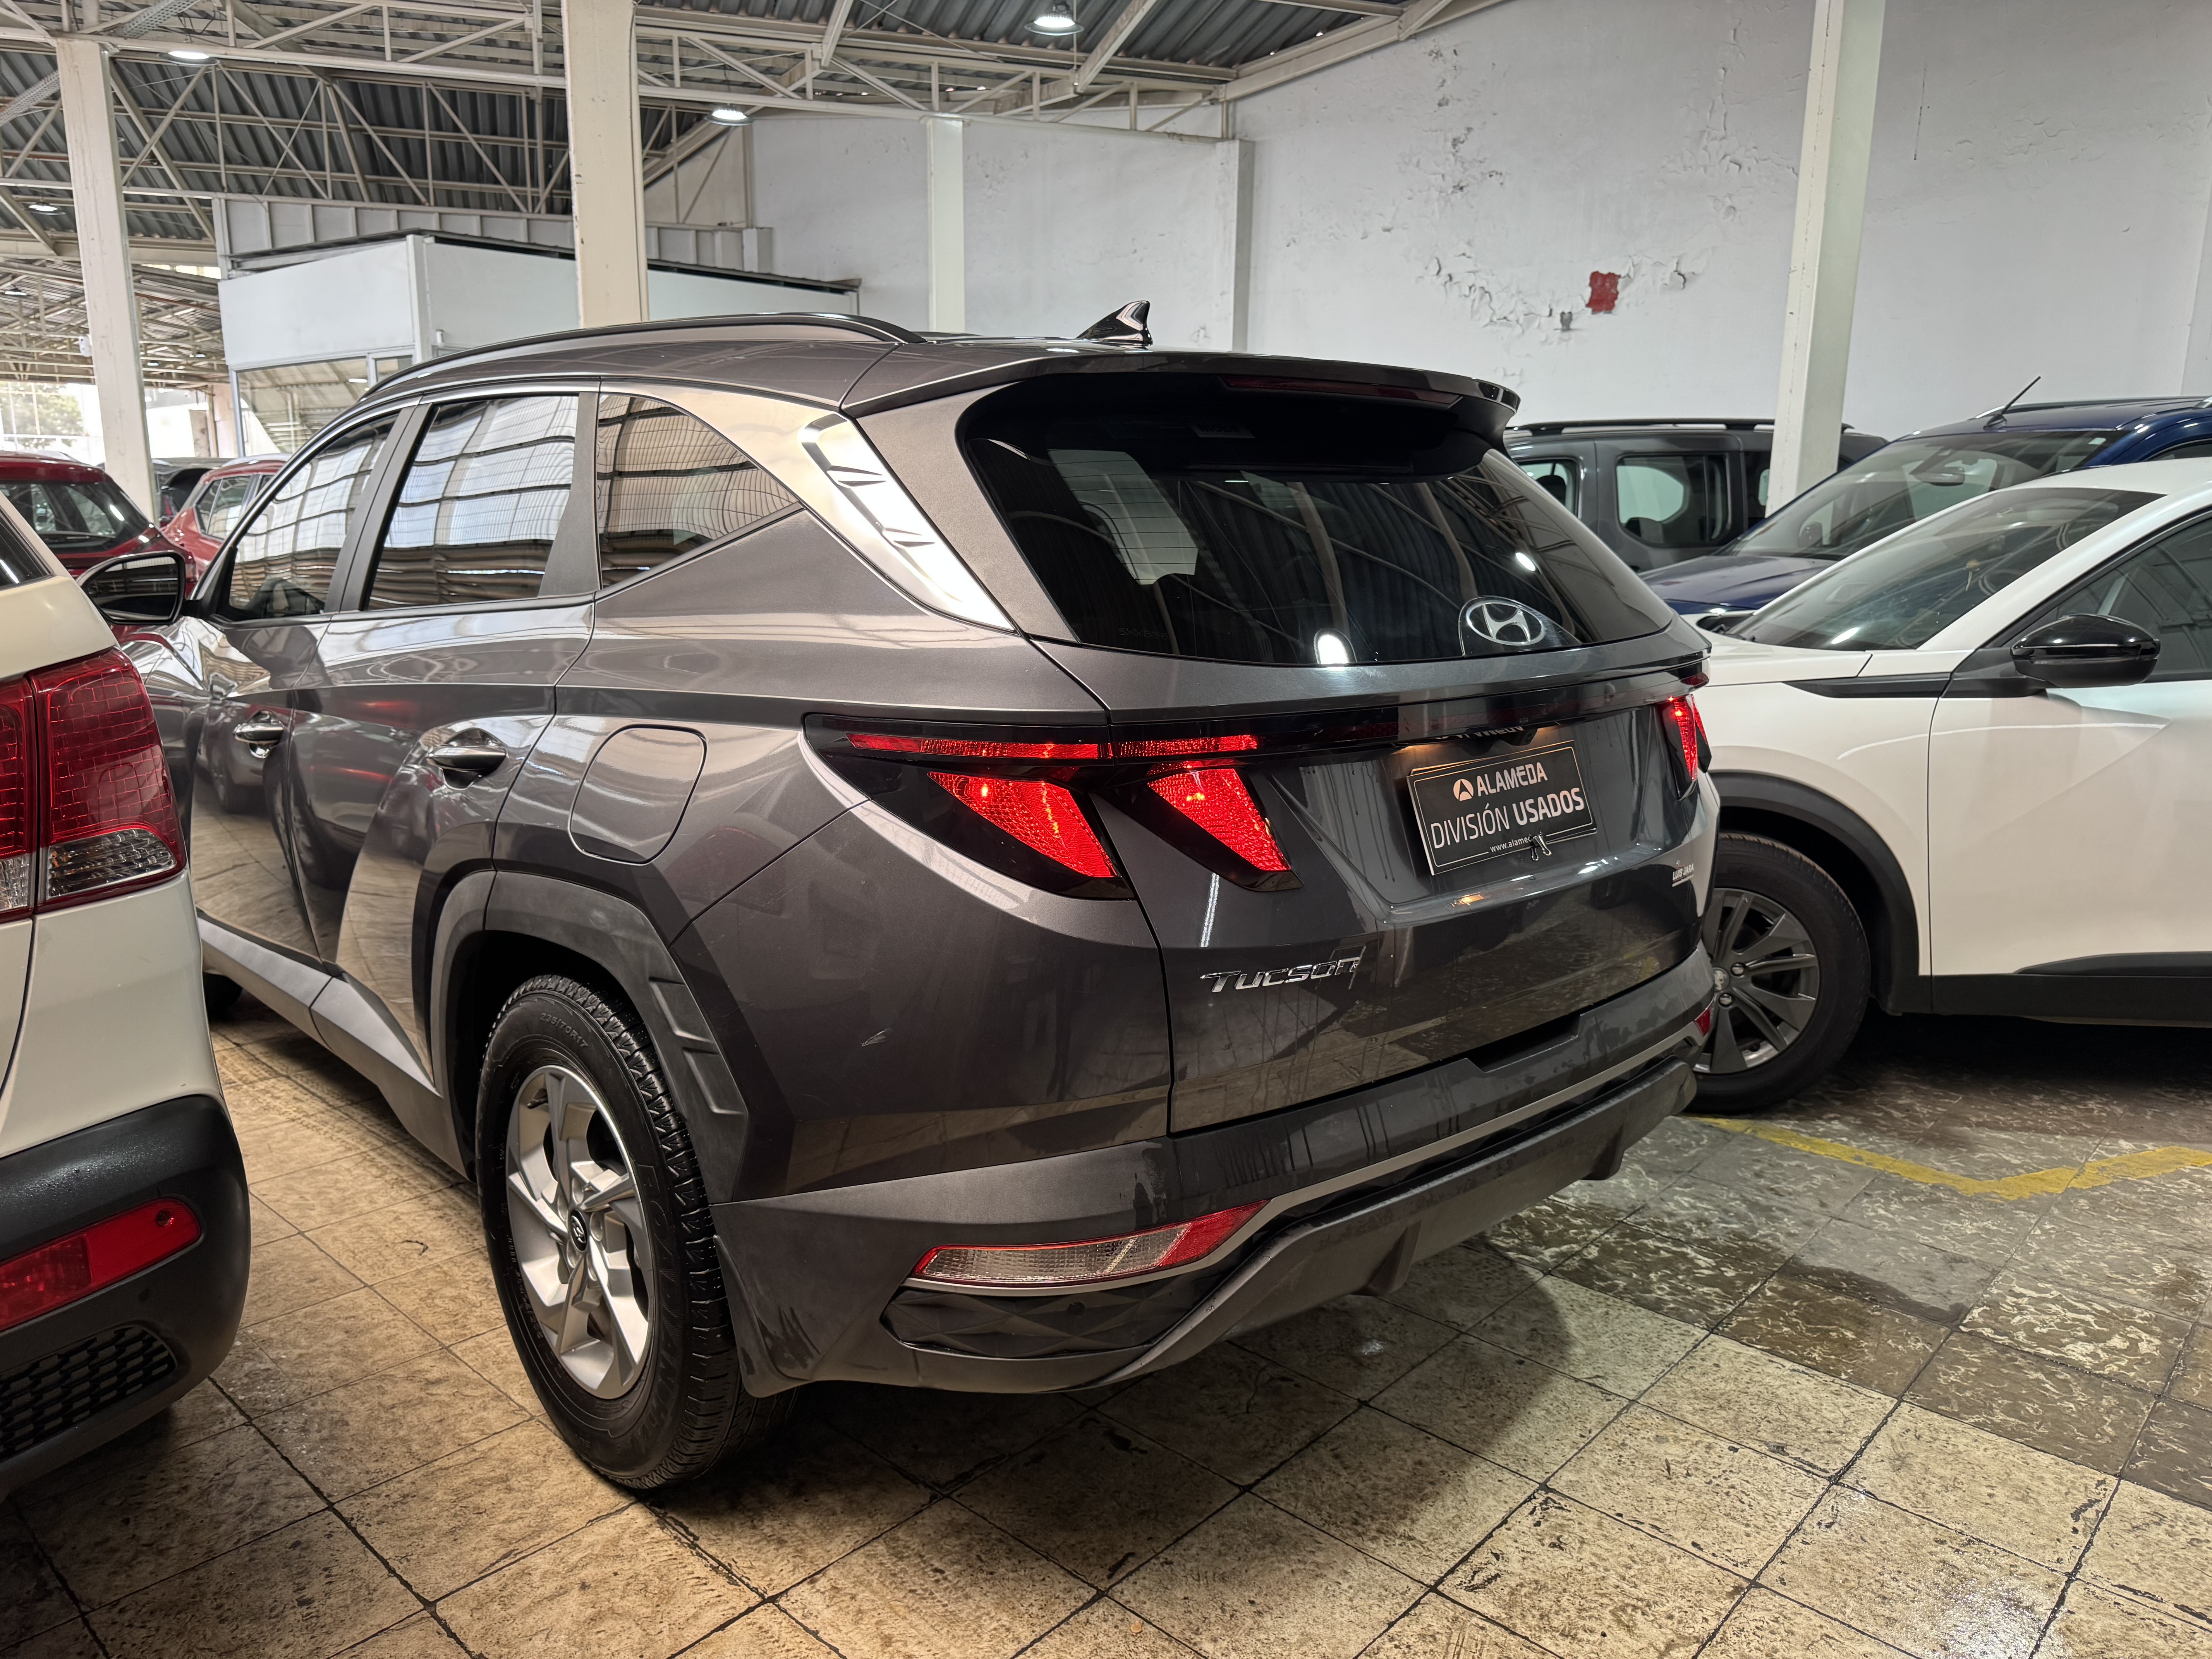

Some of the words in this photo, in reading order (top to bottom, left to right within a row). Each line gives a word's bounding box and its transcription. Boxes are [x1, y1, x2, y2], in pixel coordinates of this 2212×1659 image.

[1476, 762, 1548, 797] ALAMEDA
[1430, 803, 1510, 849] DIVISIÓN
[1512, 787, 1584, 826] USADOS
[1200, 956, 1360, 993] TUCSON
